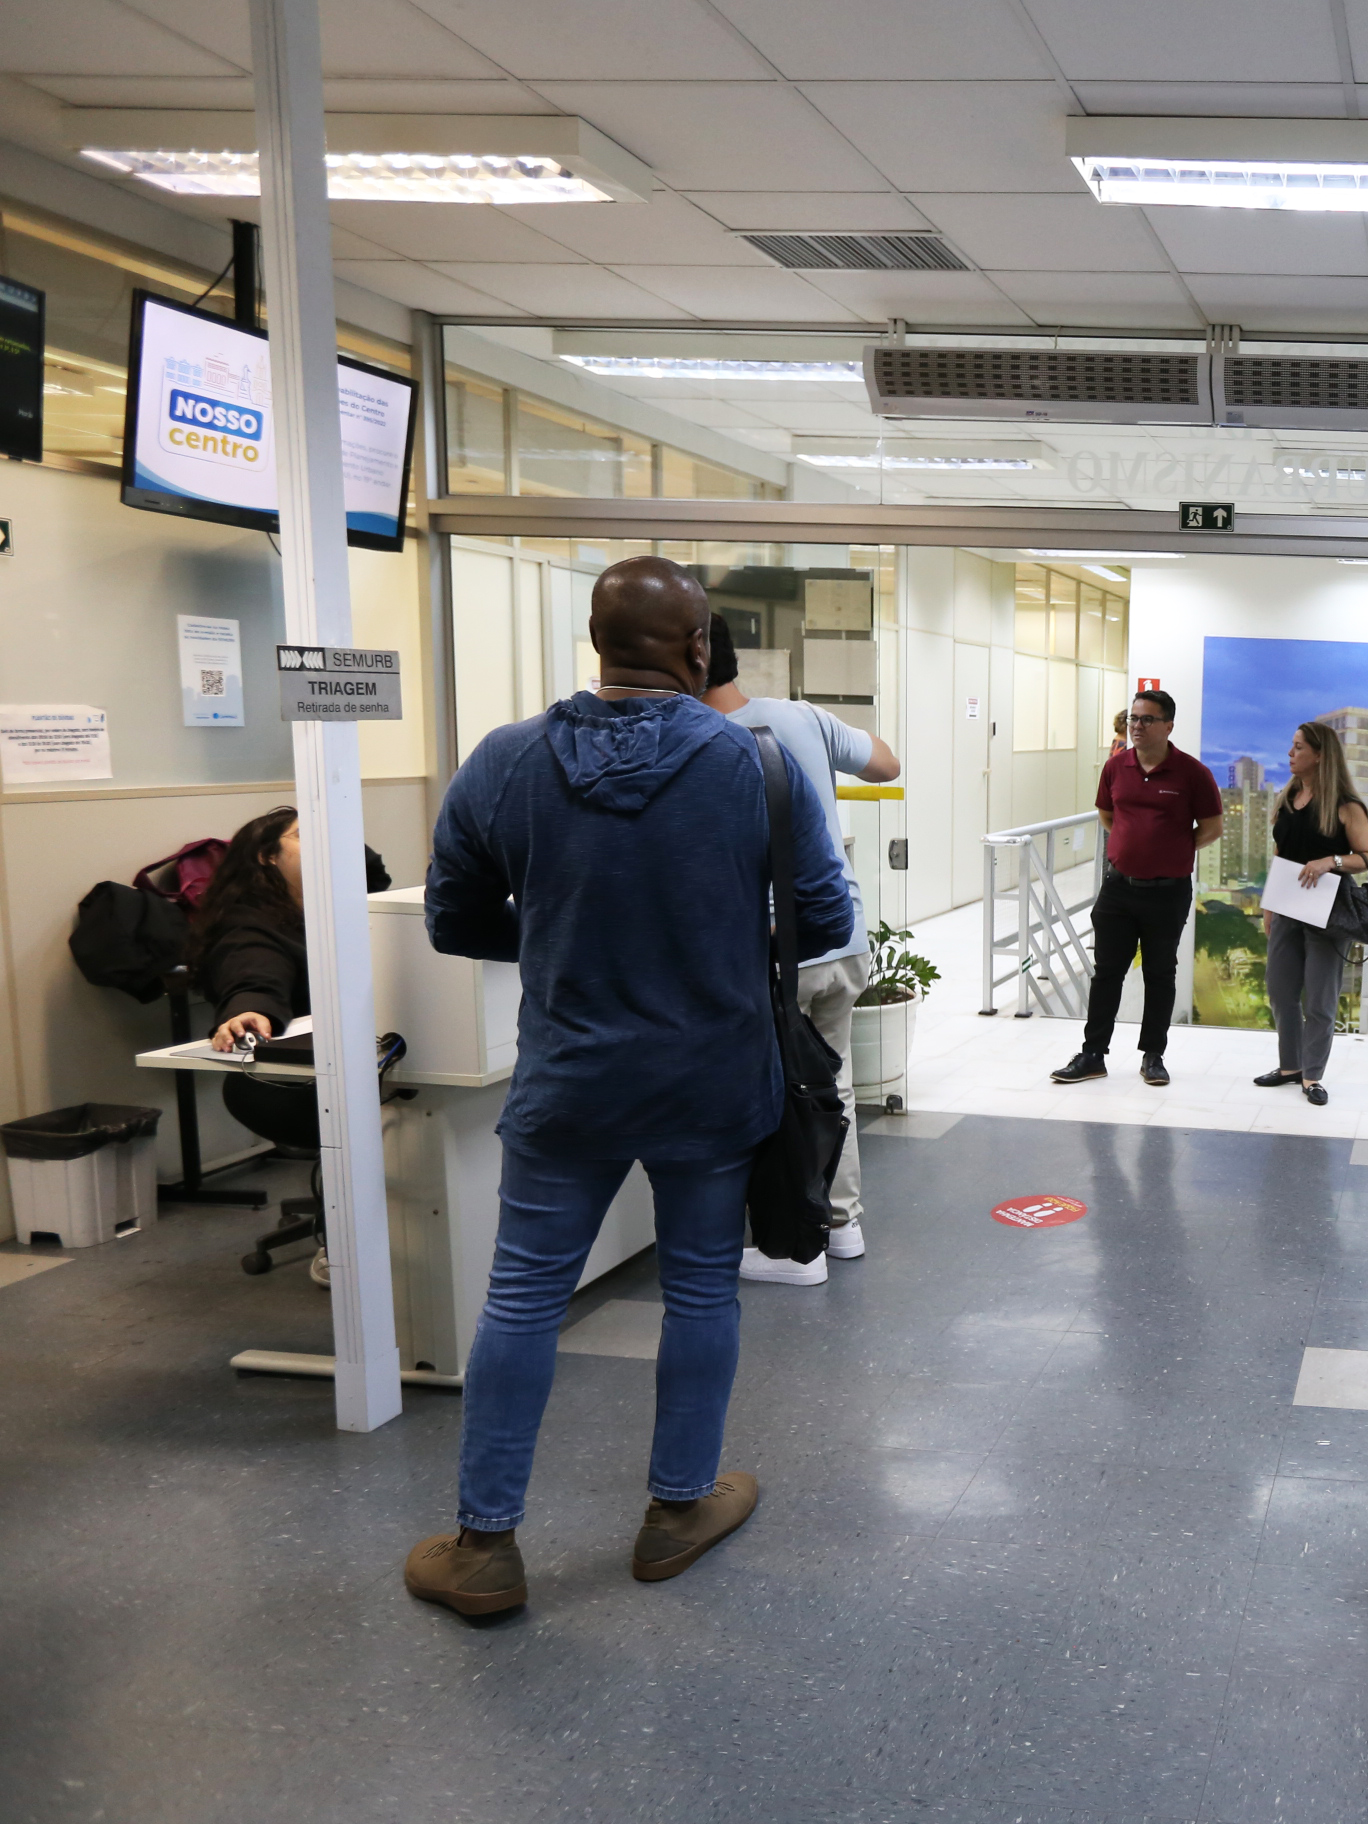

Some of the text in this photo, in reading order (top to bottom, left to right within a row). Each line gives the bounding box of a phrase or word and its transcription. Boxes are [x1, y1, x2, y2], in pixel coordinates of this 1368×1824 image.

[340, 387, 375, 403] abilitação
[174, 396, 258, 435] NOSSO
[361, 405, 385, 418] Centro
[169, 427, 259, 463] centro
[333, 652, 393, 668] SEMURB
[308, 681, 377, 696] TRIAGEM
[297, 701, 389, 713] Retirada de senha
